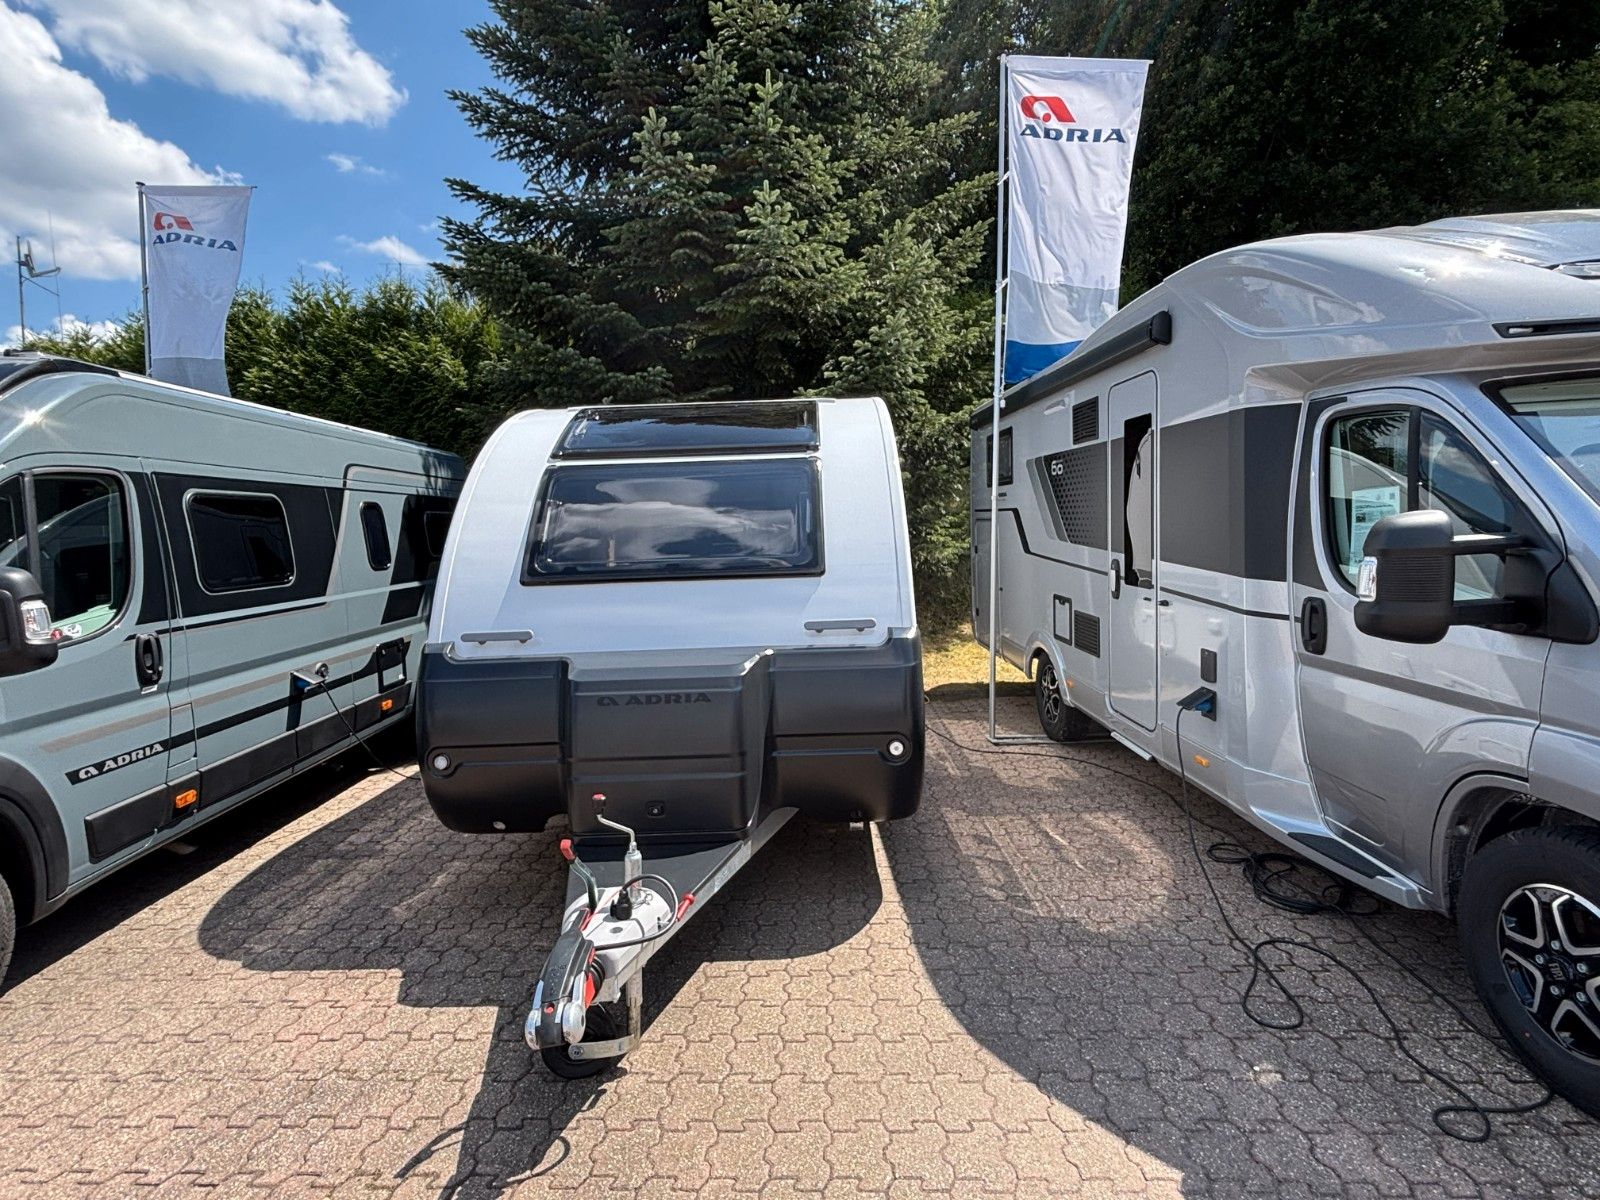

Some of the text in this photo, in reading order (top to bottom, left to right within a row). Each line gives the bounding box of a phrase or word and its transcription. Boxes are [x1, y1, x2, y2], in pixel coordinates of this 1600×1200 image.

[1020, 124, 1126, 143] ADRIA
[153, 232, 237, 252] ADRIA
[624, 692, 712, 706] ADRIA
[102, 743, 165, 772] ADRIA
